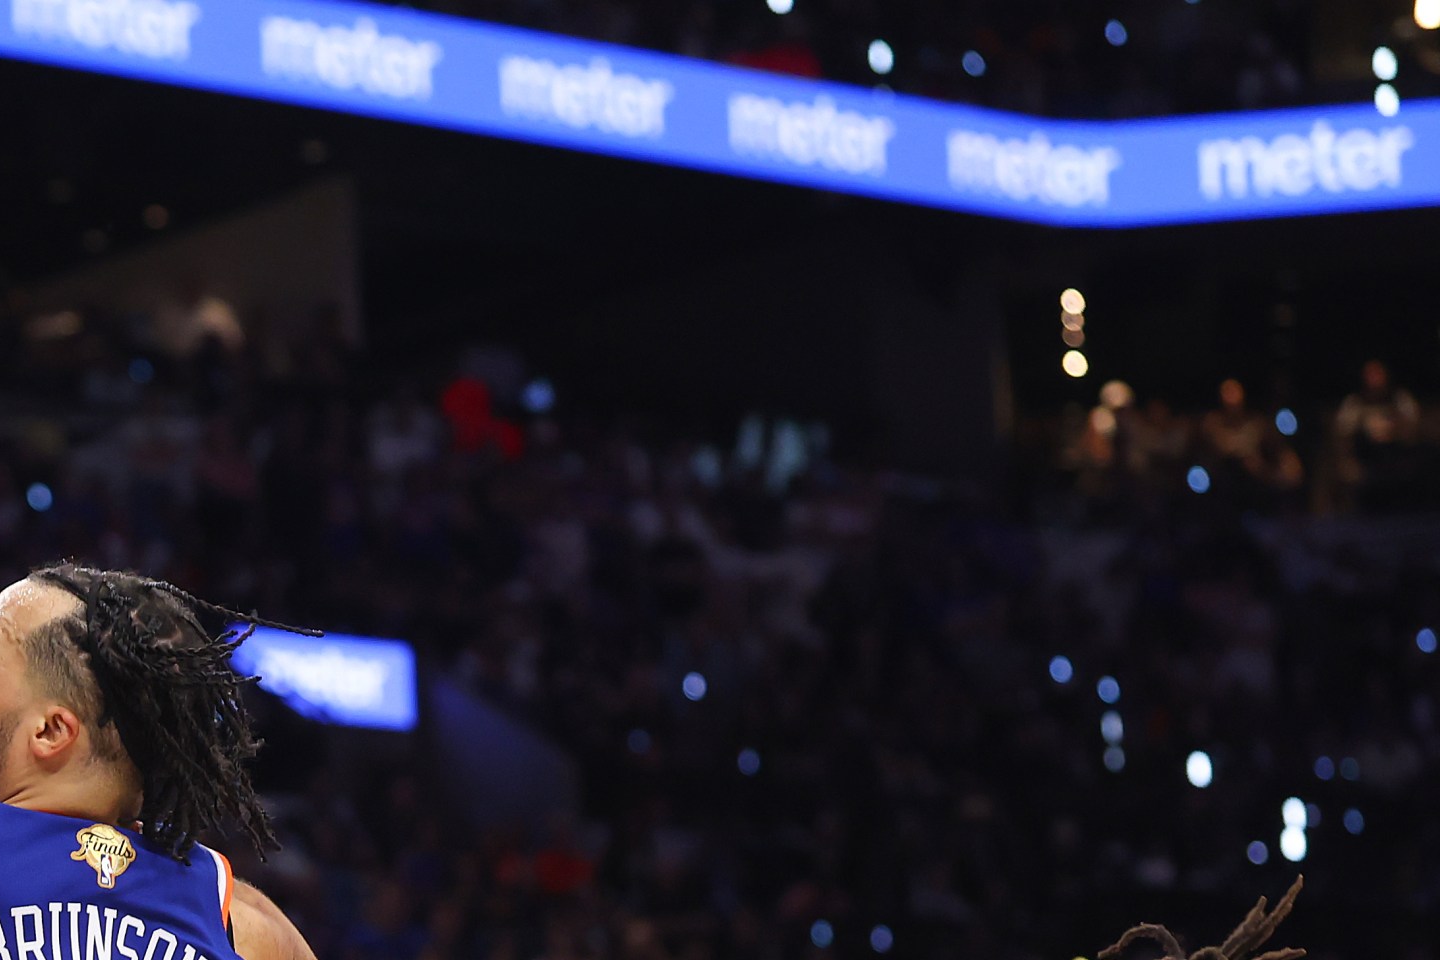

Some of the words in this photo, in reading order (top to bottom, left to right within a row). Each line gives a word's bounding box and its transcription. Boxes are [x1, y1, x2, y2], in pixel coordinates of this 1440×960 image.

[728, 93, 894, 177] meter
[948, 127, 1122, 207] meter
[1198, 118, 1412, 201] meter
[76, 831, 134, 859] Finals
